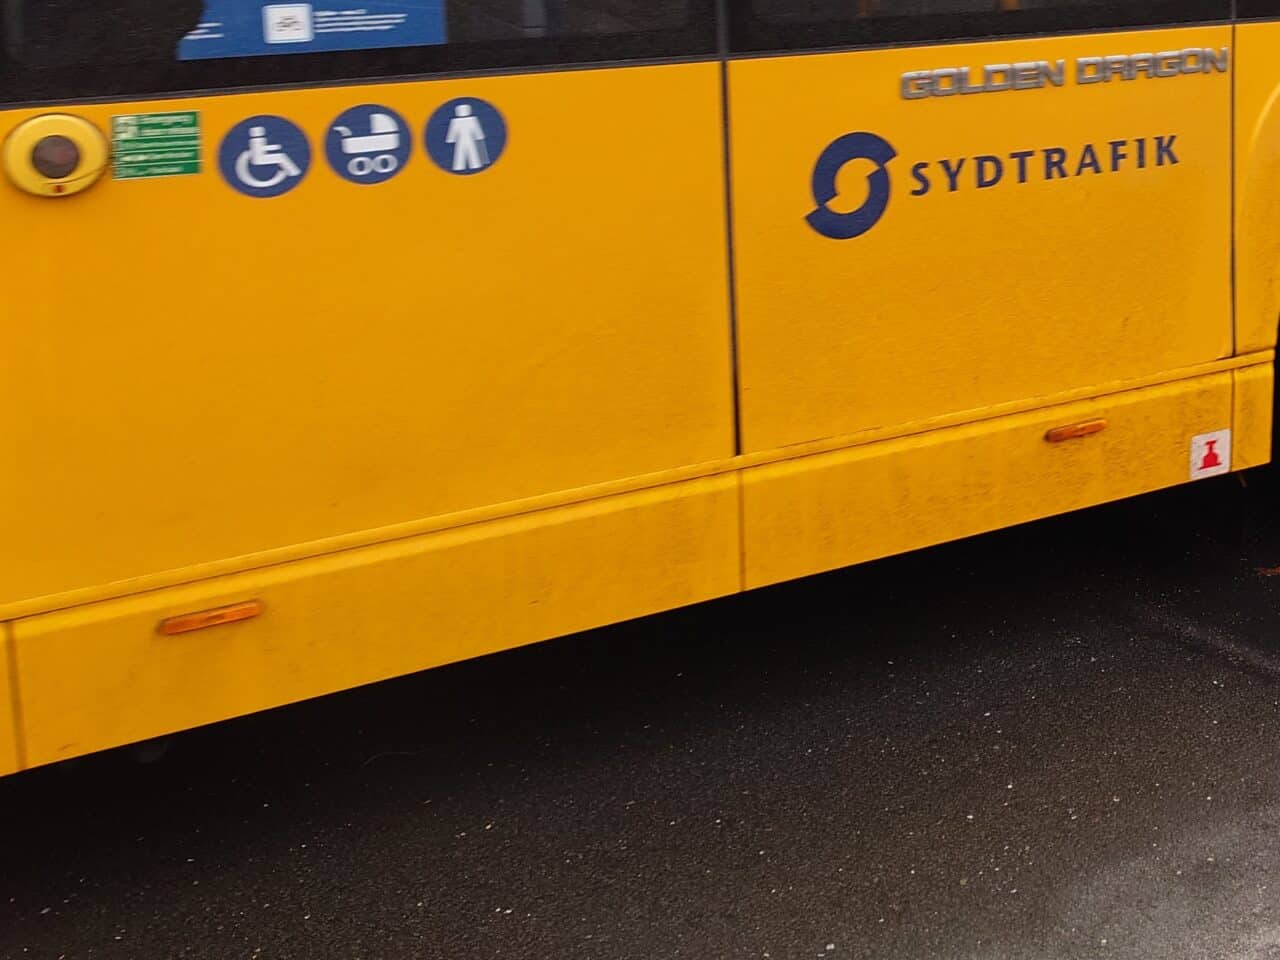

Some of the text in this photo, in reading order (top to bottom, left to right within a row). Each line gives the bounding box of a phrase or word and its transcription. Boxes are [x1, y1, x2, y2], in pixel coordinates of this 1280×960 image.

[901, 46, 1229, 100] GOLDEN DRAGON
[910, 134, 1179, 197] SYDTRAFIK
